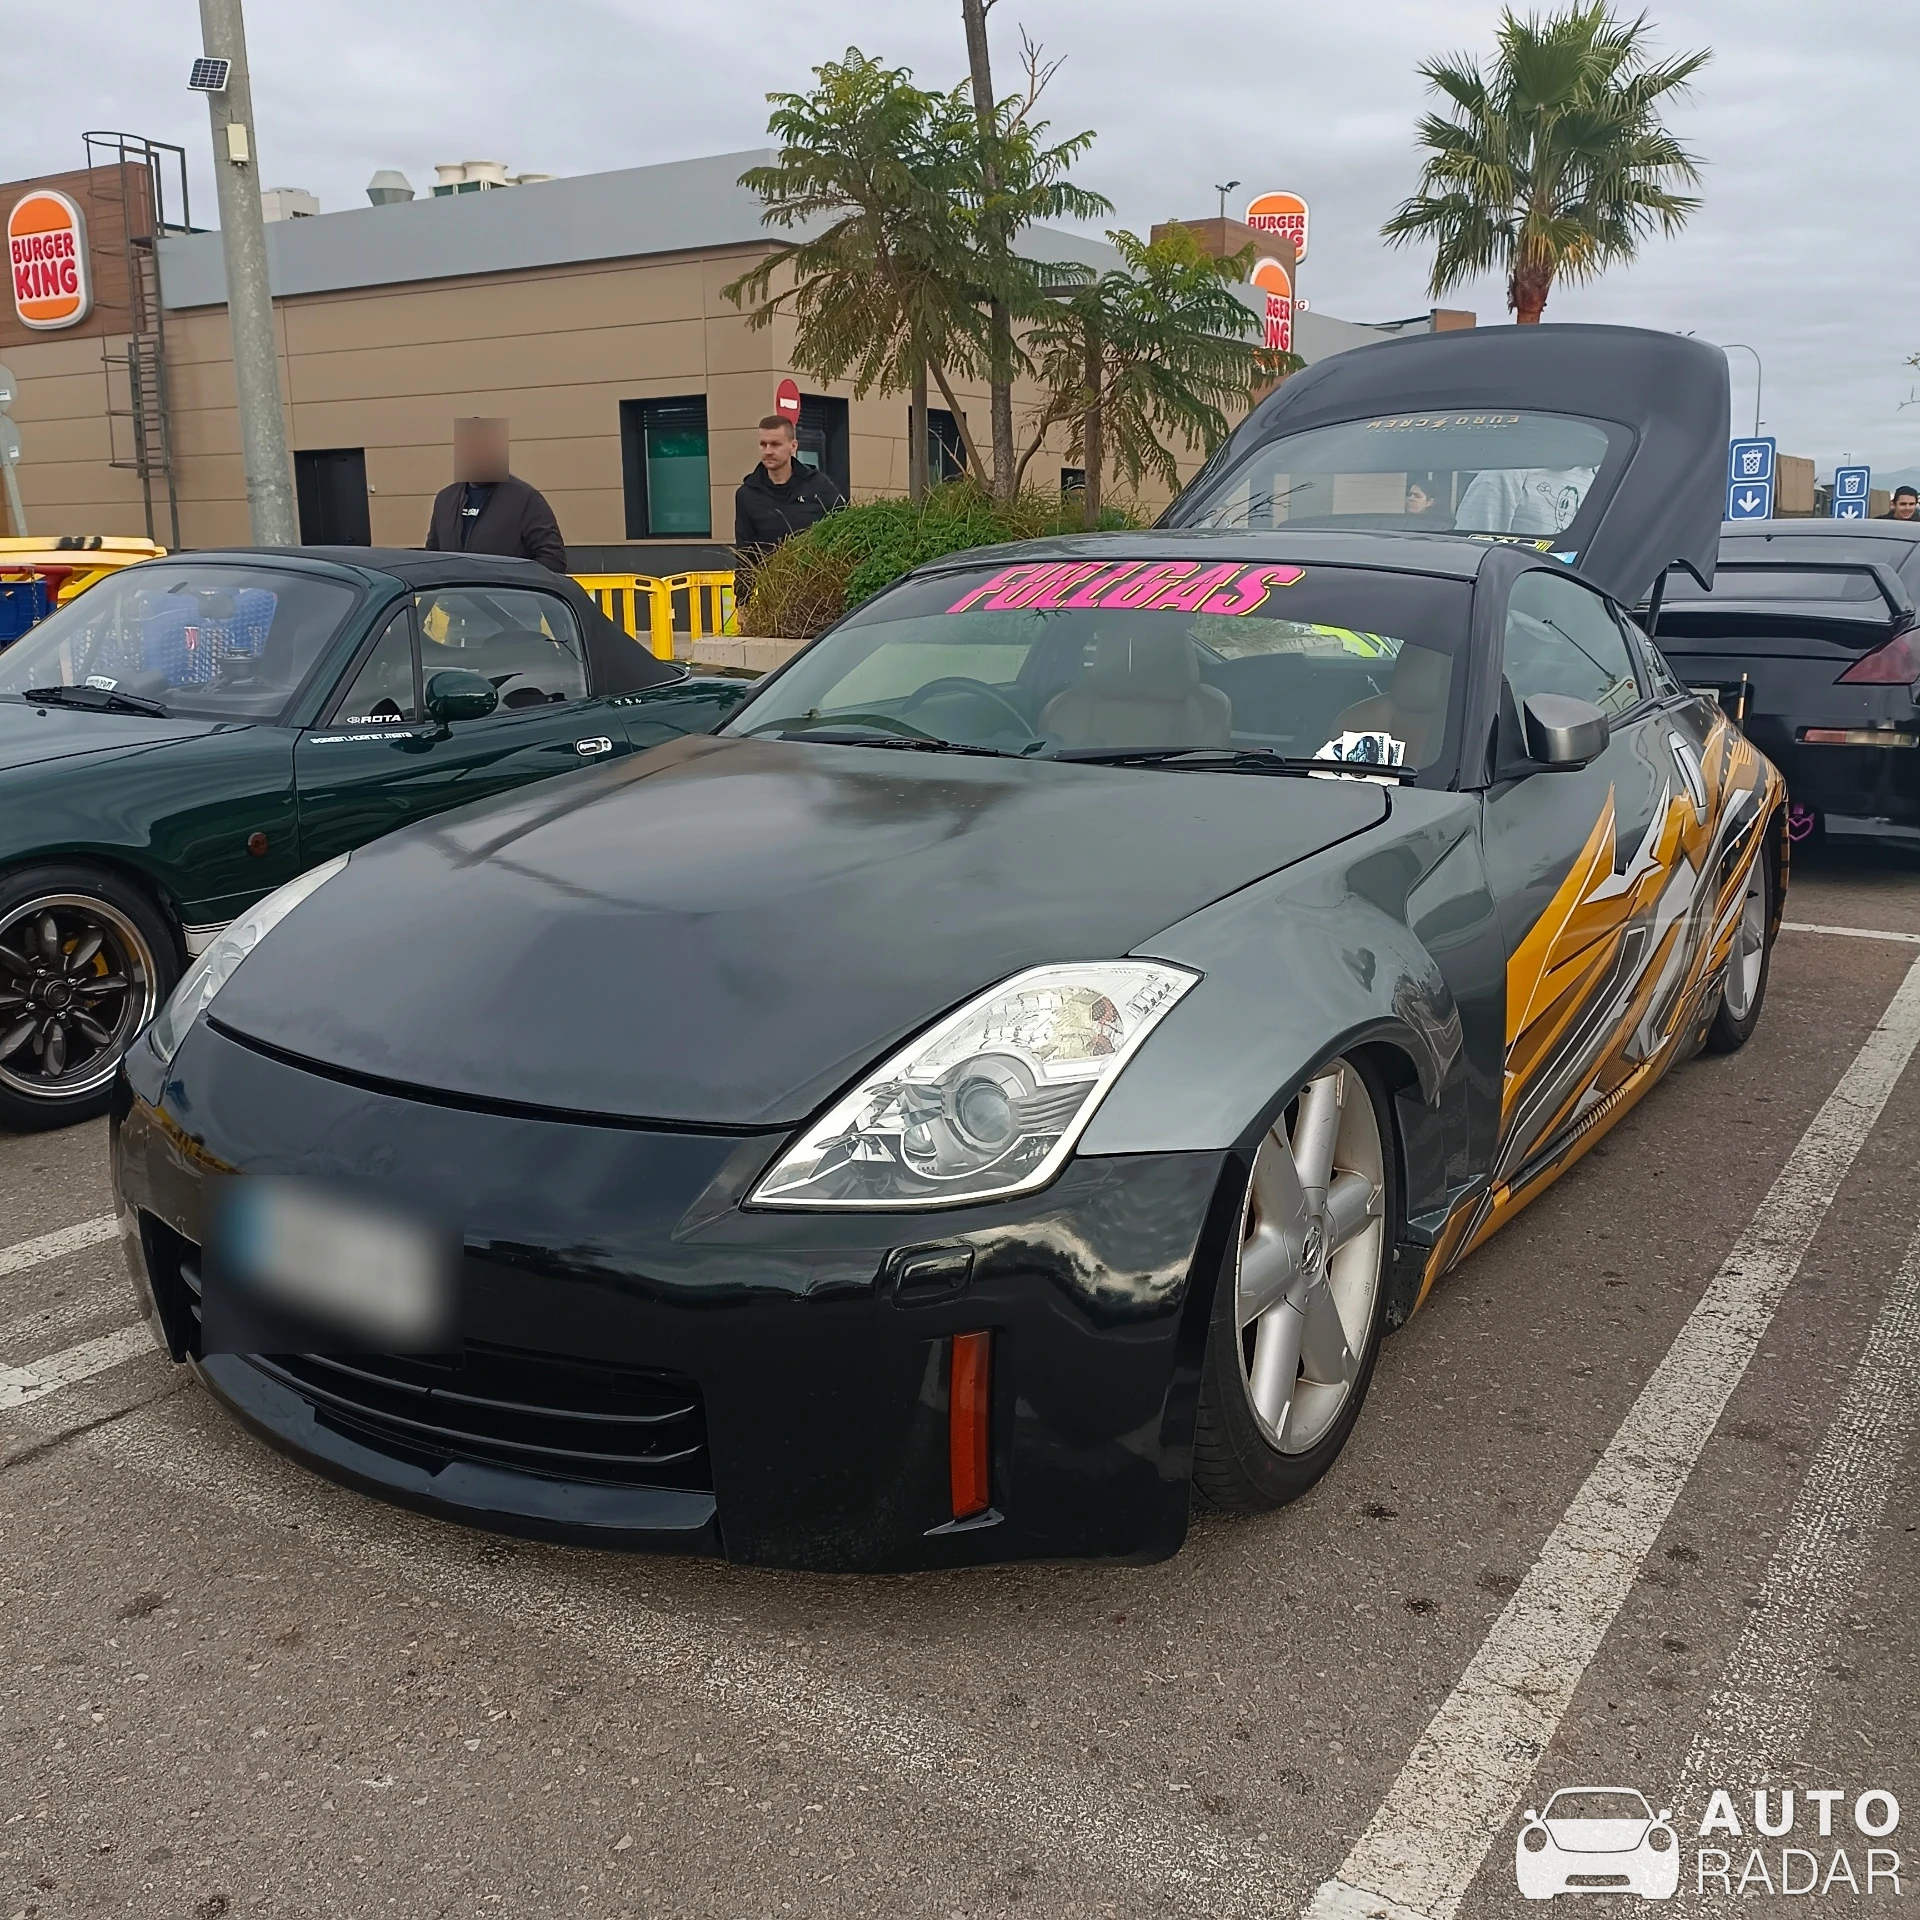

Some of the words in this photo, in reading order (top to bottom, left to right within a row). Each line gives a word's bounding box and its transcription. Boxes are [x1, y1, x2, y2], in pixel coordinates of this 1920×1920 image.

[1248, 215, 1305, 230] BURGER
[12, 232, 75, 264] BURGER
[14, 258, 78, 300] KING
[1266, 297, 1290, 321] RGER
[1265, 318, 1289, 350] ING
[1366, 418, 1429, 429] CREW
[1455, 415, 1520, 425] EURO
[945, 561, 1306, 616] FULLGAS
[360, 714, 402, 724] ROTA
